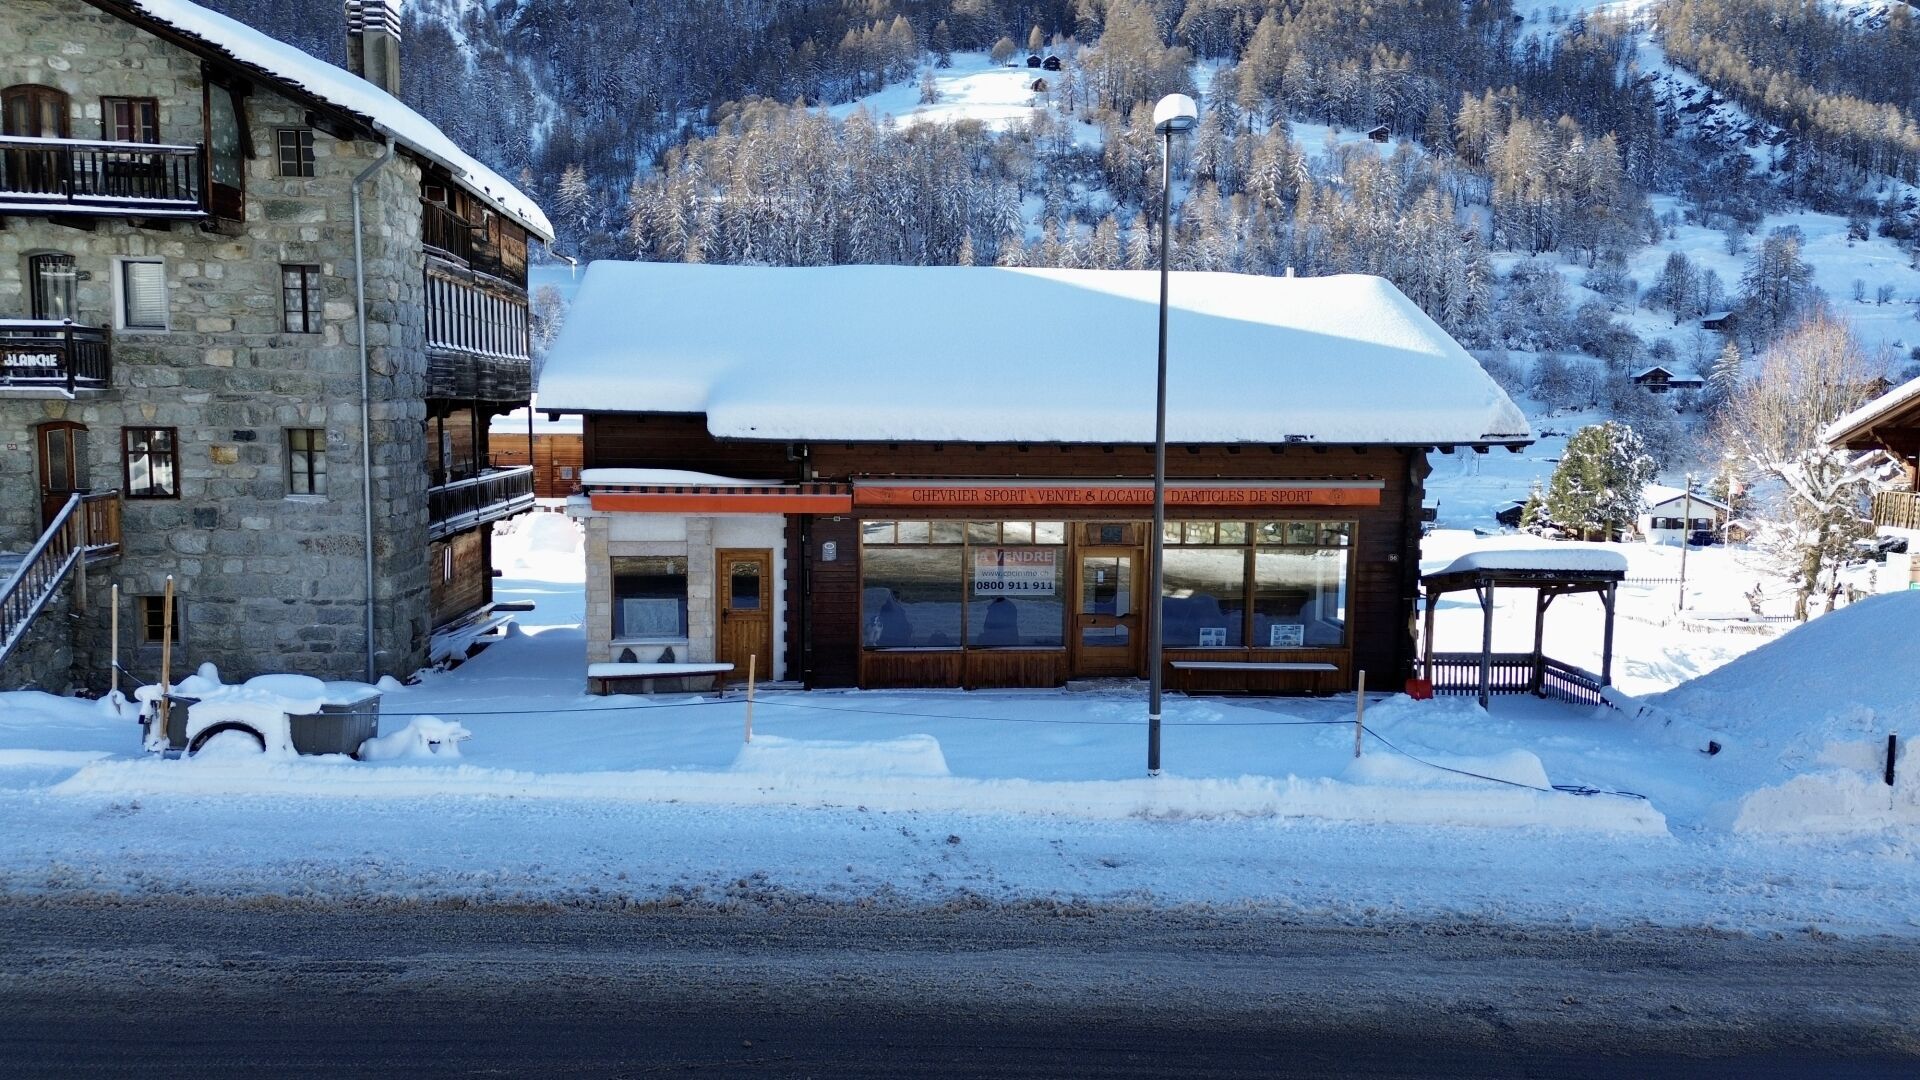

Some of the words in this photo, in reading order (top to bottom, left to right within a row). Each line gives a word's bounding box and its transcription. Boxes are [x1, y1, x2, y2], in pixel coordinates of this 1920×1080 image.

[912, 489, 979, 502] CHEVRIER
[984, 489, 1026, 502] SPORT
[1038, 489, 1081, 502] VENTE
[1085, 490, 1096, 502] &
[1100, 489, 1156, 502] LOCATIO
[1171, 490, 1244, 502] D'ARTICLES
[1249, 490, 1267, 502] DE
[1271, 490, 1313, 502] SPORT
[994, 551, 1052, 562] VENDRE
[976, 581, 1004, 590] 0800
[1008, 581, 1028, 590] 911
[1032, 581, 1053, 590] 911
